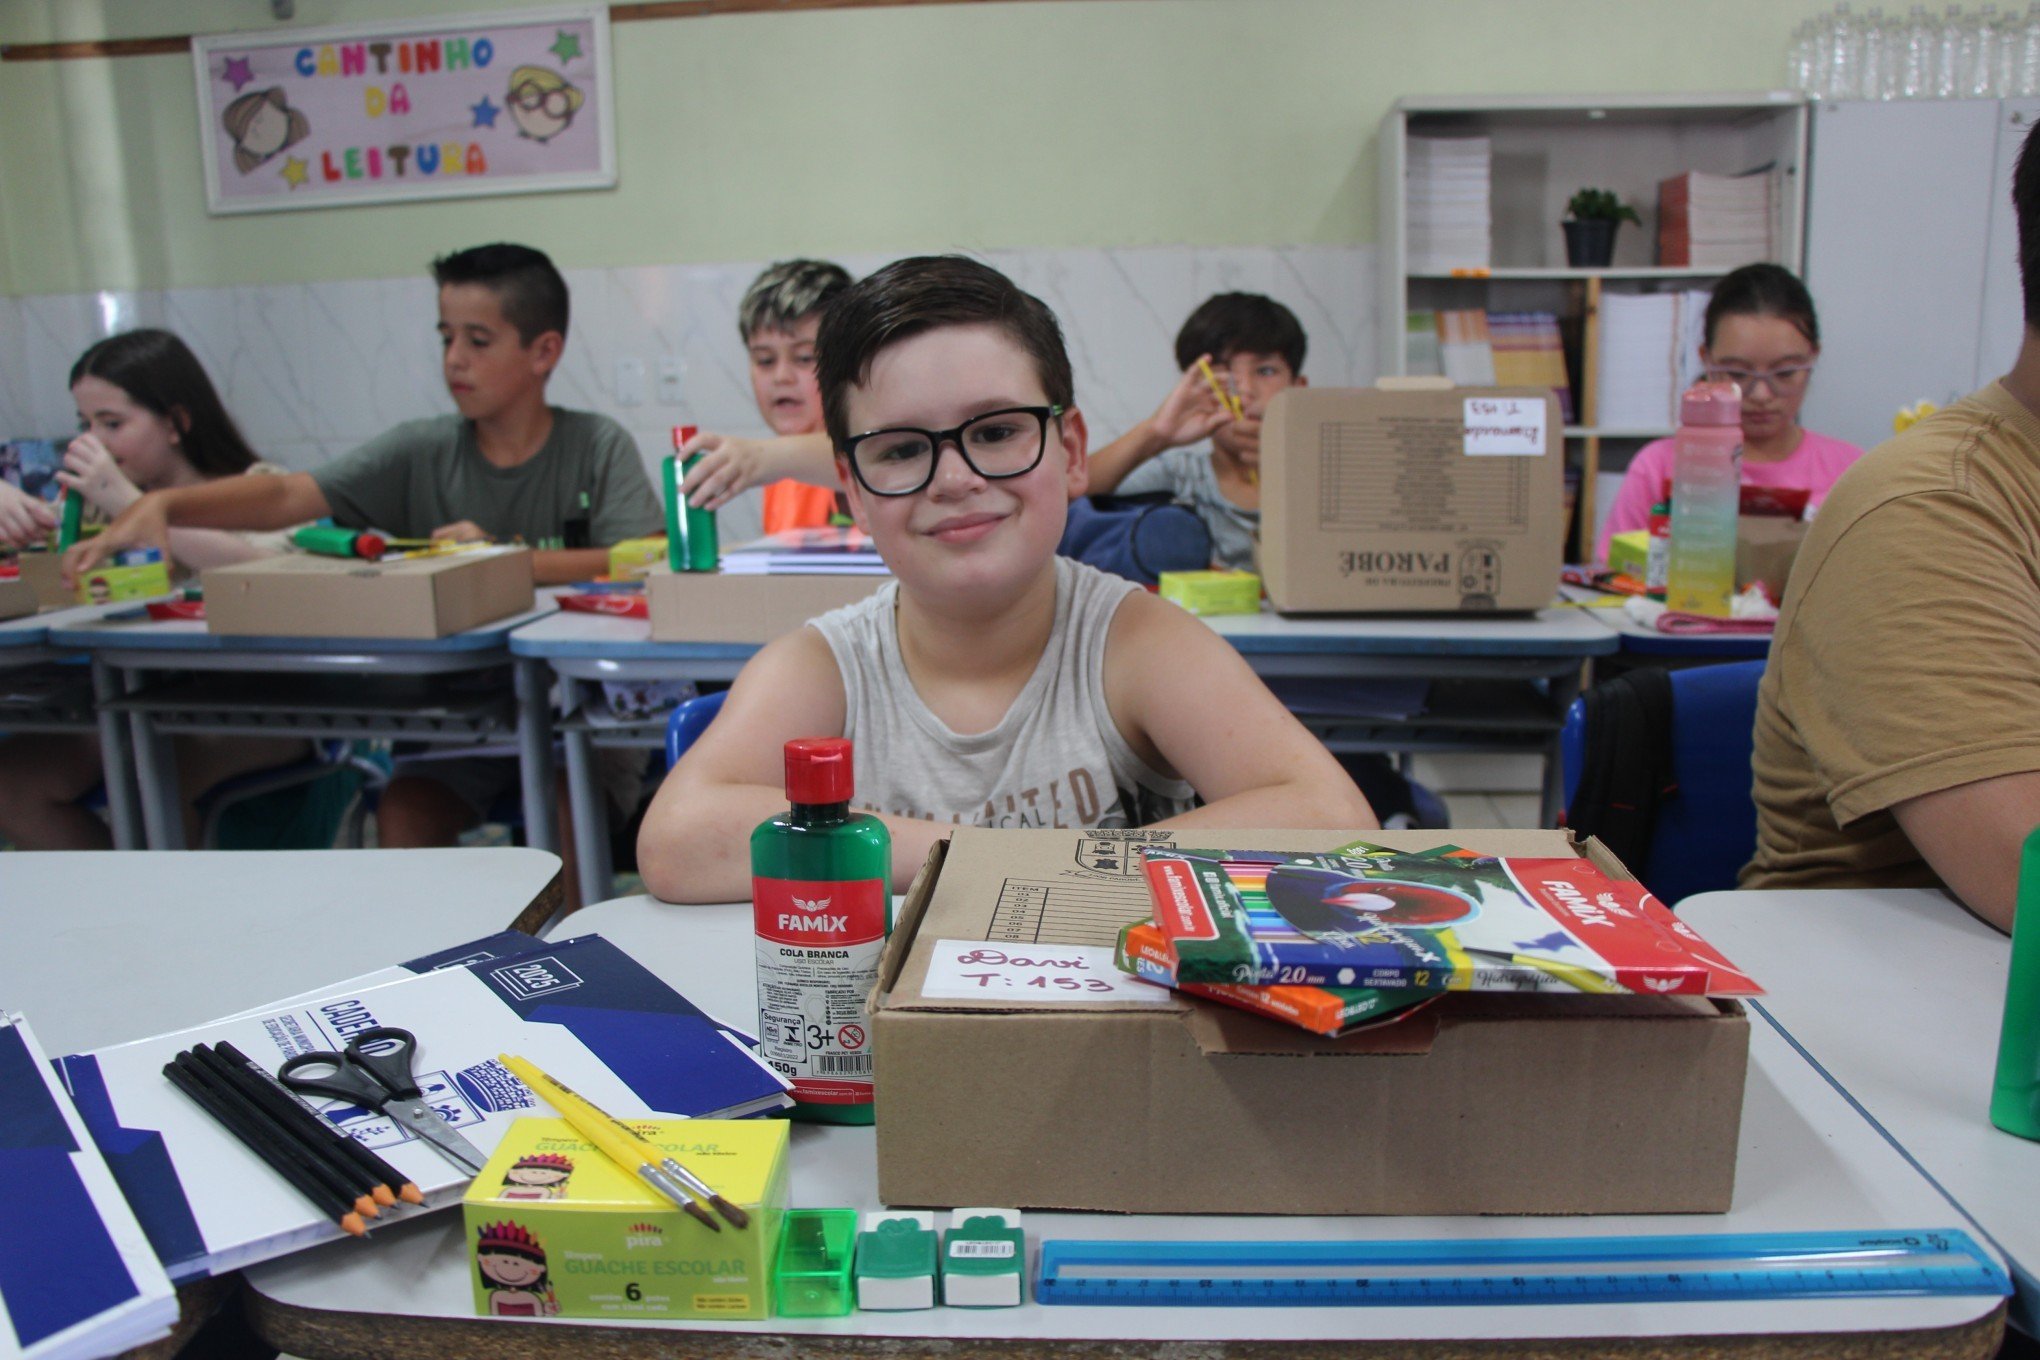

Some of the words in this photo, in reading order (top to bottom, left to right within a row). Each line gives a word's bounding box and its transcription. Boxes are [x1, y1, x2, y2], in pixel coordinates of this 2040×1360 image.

[295, 38, 494, 76] CANTINHO
[364, 83, 411, 118] DA
[321, 142, 488, 181] LEITURA
[1339, 550, 1450, 577] PAROBÉ
[780, 948, 803, 957] COLA
[807, 950, 849, 958] BRANCA
[512, 964, 560, 989] 2025
[1028, 976, 1114, 992] 153
[1414, 971, 1429, 986] 12
[764, 1013, 801, 1025] Segurança
[807, 1024, 834, 1049] 3+
[625, 1236, 663, 1249] pira
[564, 1261, 648, 1275] GUACHE
[654, 1260, 746, 1275] ESCOLAR
[625, 1282, 642, 1302] 6
